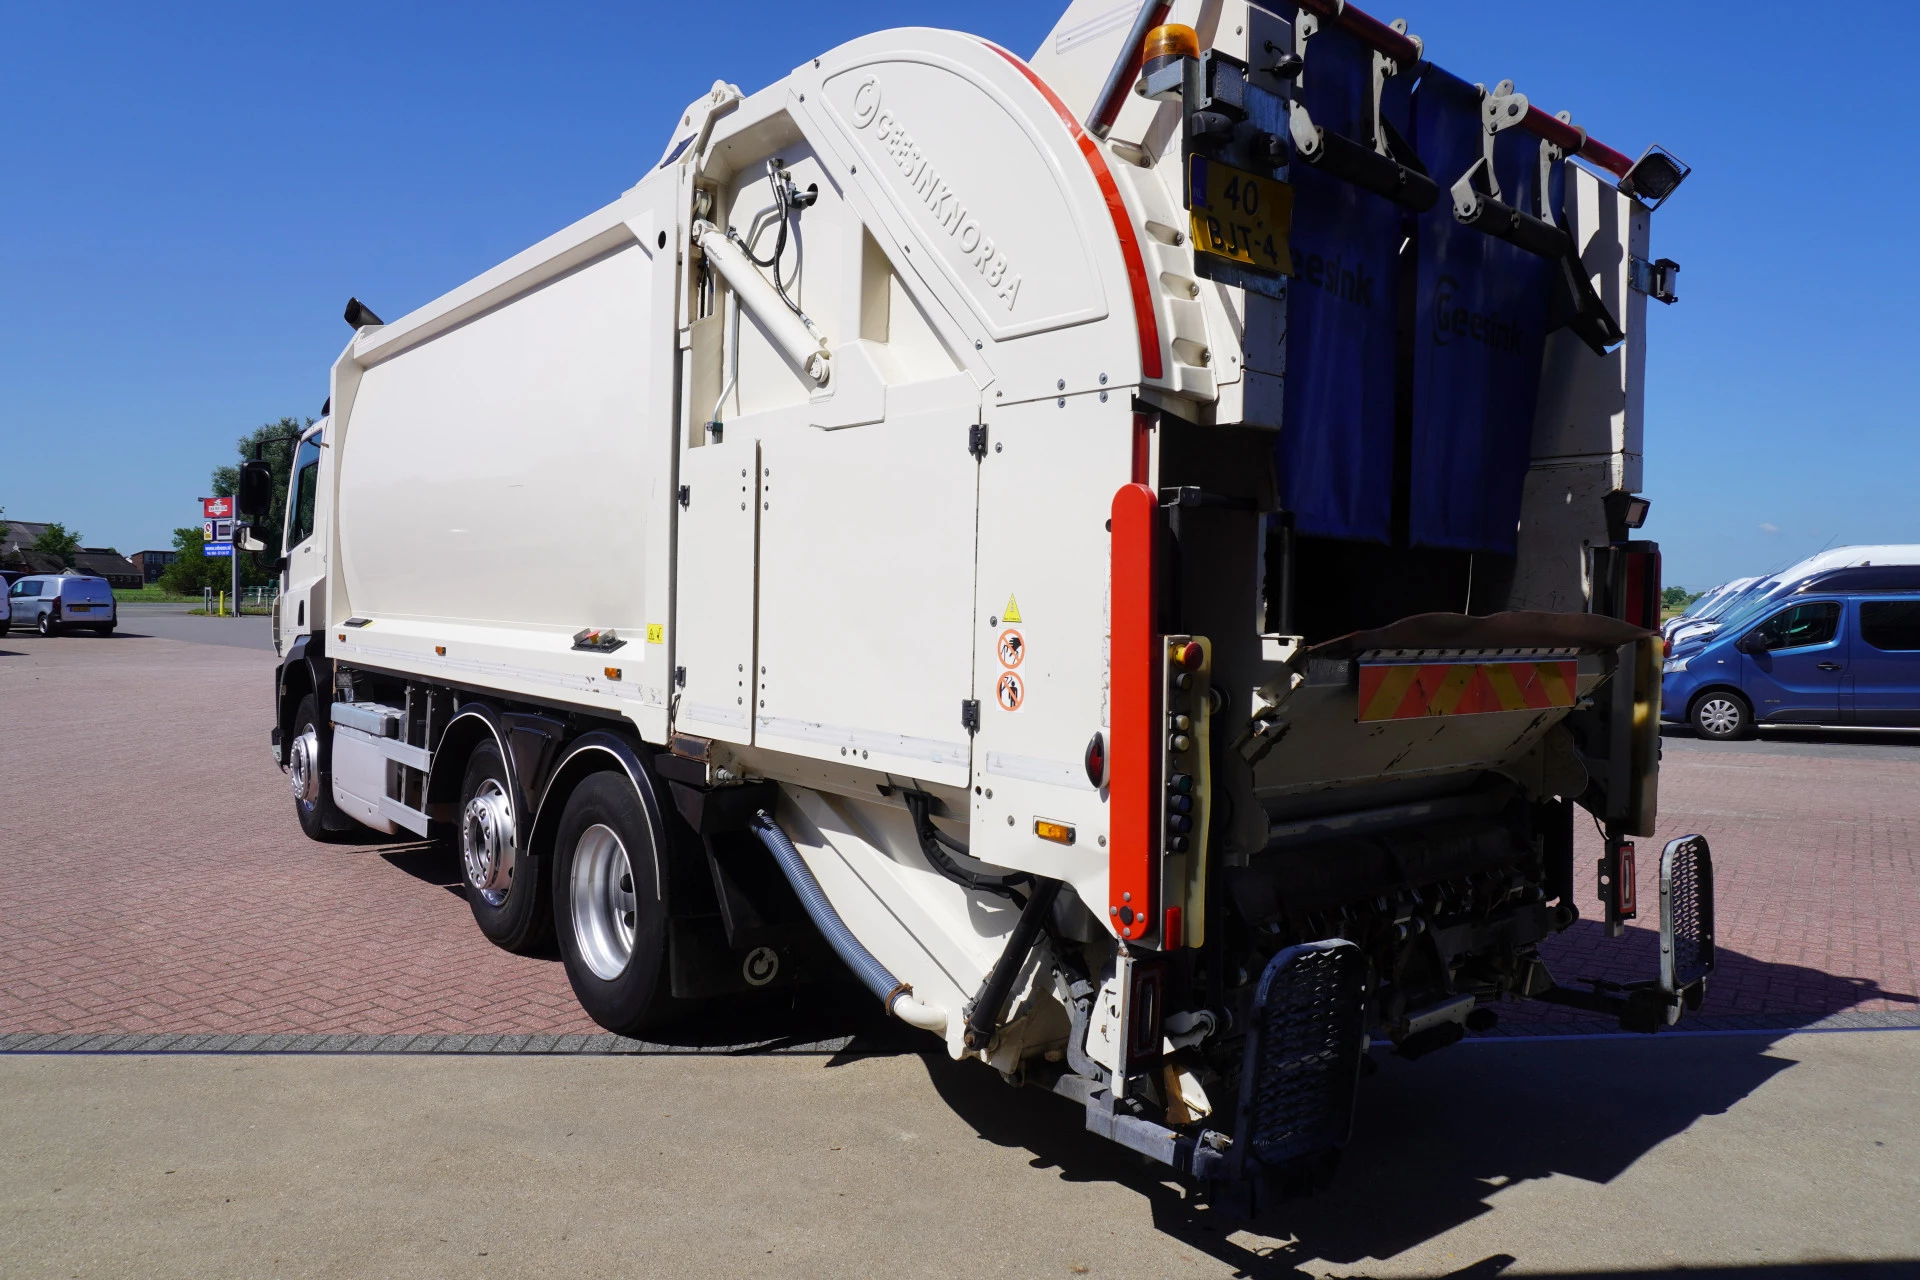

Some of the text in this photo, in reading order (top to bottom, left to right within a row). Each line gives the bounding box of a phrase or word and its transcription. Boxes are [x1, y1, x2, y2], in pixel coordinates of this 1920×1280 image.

[876, 109, 1022, 311] GEESINKNORBA
[1193, 186, 1204, 200] NL
[1224, 175, 1259, 216] 40
[1207, 215, 1278, 266] BJT-4
[1290, 247, 1374, 309] eesink
[1433, 274, 1524, 355] Geesink
